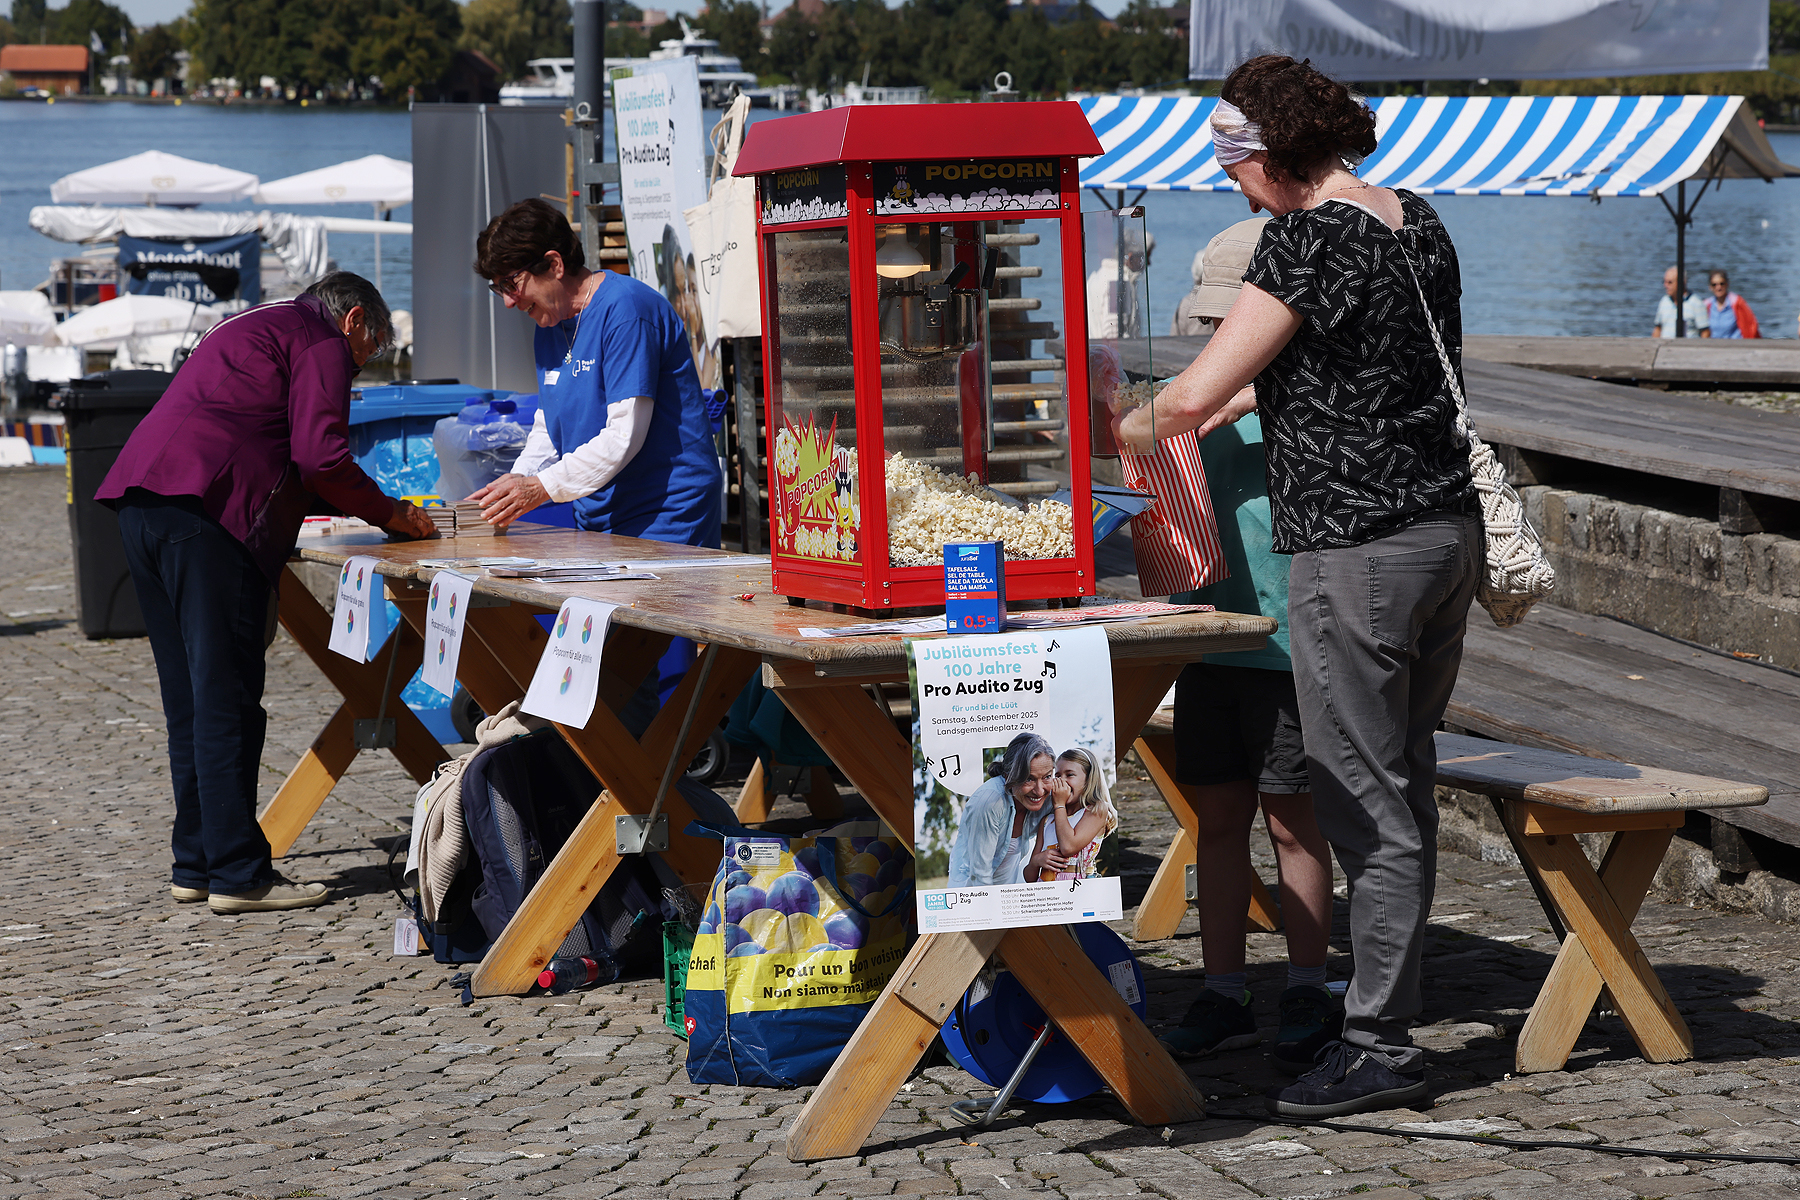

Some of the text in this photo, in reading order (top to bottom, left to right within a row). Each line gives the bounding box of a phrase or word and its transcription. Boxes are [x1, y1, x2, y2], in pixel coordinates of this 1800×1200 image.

[619, 89, 666, 112] Jubiläumsfest
[627, 116, 659, 137] 100 Jahre
[622, 144, 670, 166] Pro Audito Zug
[777, 171, 819, 189] POPCORN
[925, 162, 1053, 181] POPCORN
[164, 282, 191, 301] ab
[787, 462, 837, 510] POPCORN
[964, 616, 986, 629] 0,5
[553, 646, 568, 658] Popcorn
[581, 654, 592, 664] gratis
[924, 642, 1038, 660] Jubiläumsfest
[944, 661, 1021, 677] 100 Jahre
[924, 678, 1044, 697] Pro Audito Zug
[965, 704, 979, 712] und
[1001, 701, 1018, 709] Lüüt
[932, 716, 968, 725] Samstag,
[1021, 711, 1039, 719] 2025
[937, 723, 1034, 736] Landsgemeindeplatz Zug
[690, 955, 716, 970] chaf
[774, 963, 815, 979] Pour
[822, 963, 843, 978] un
[849, 958, 868, 974] bon
[763, 985, 793, 999] Non
[796, 982, 839, 997] siamo
[843, 979, 864, 994] mai
[866, 972, 885, 990] stati
